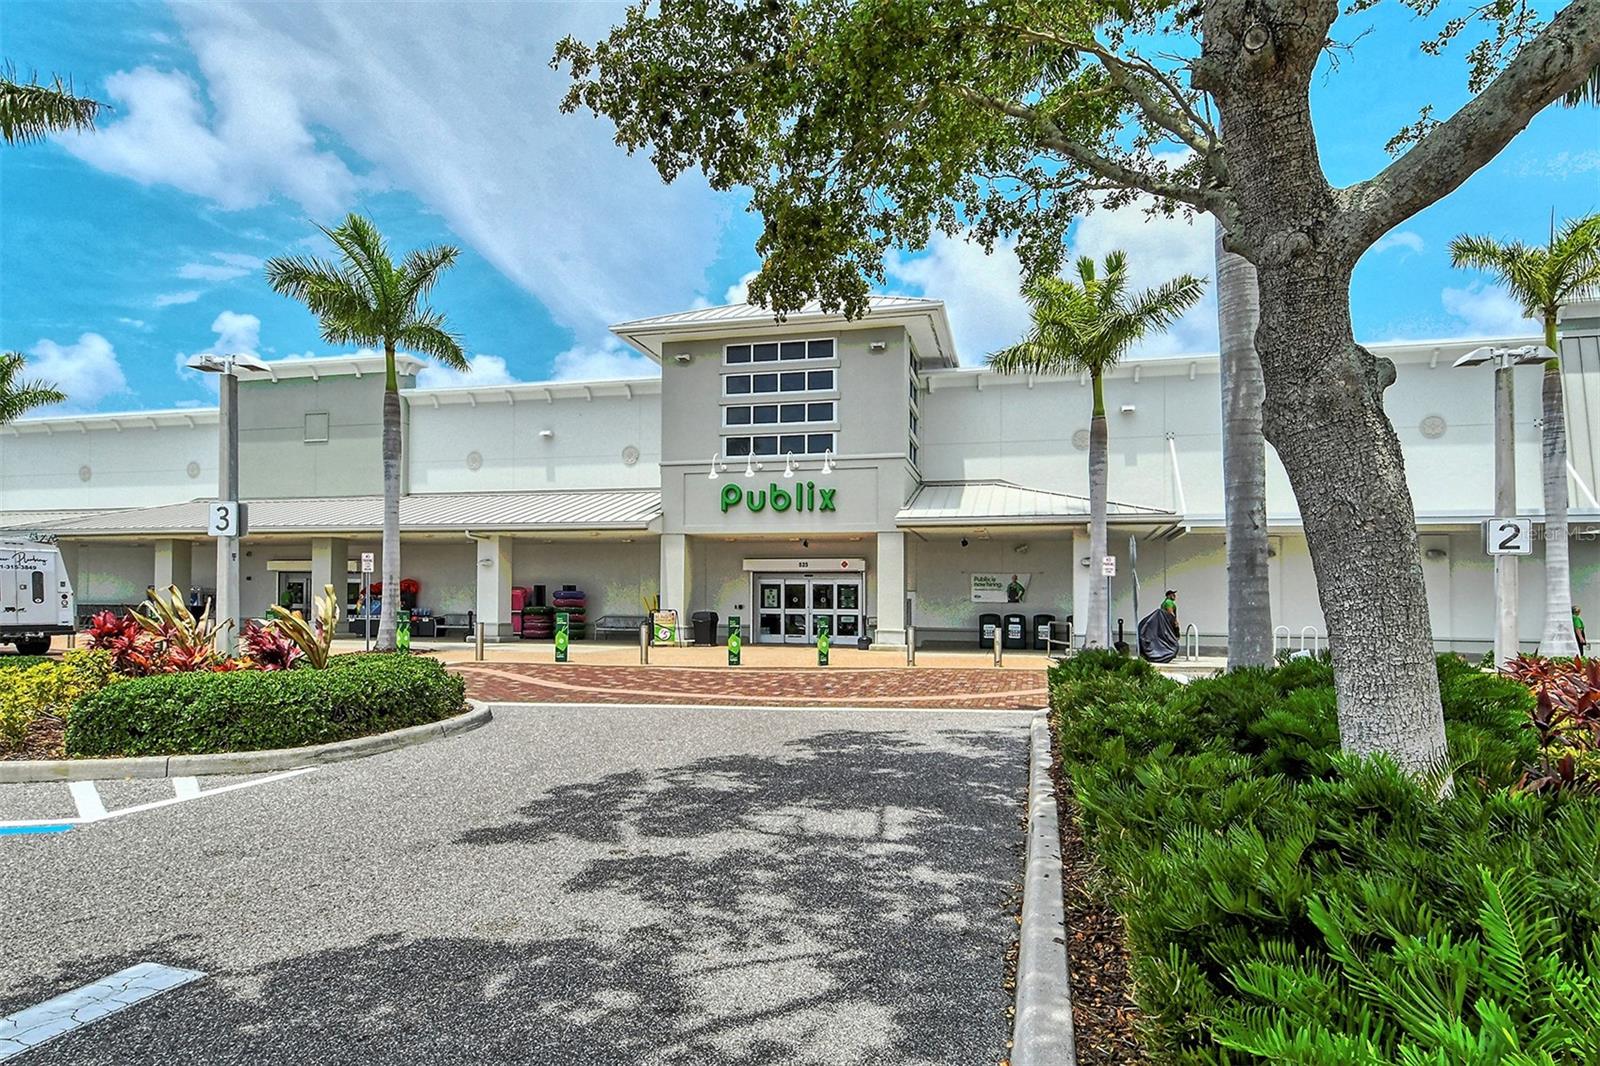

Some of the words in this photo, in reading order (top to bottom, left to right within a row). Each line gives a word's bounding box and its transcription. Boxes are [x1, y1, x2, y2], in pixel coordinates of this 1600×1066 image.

[720, 480, 837, 513] Publix
[215, 506, 229, 531] 3
[1498, 523, 1520, 549] 2
